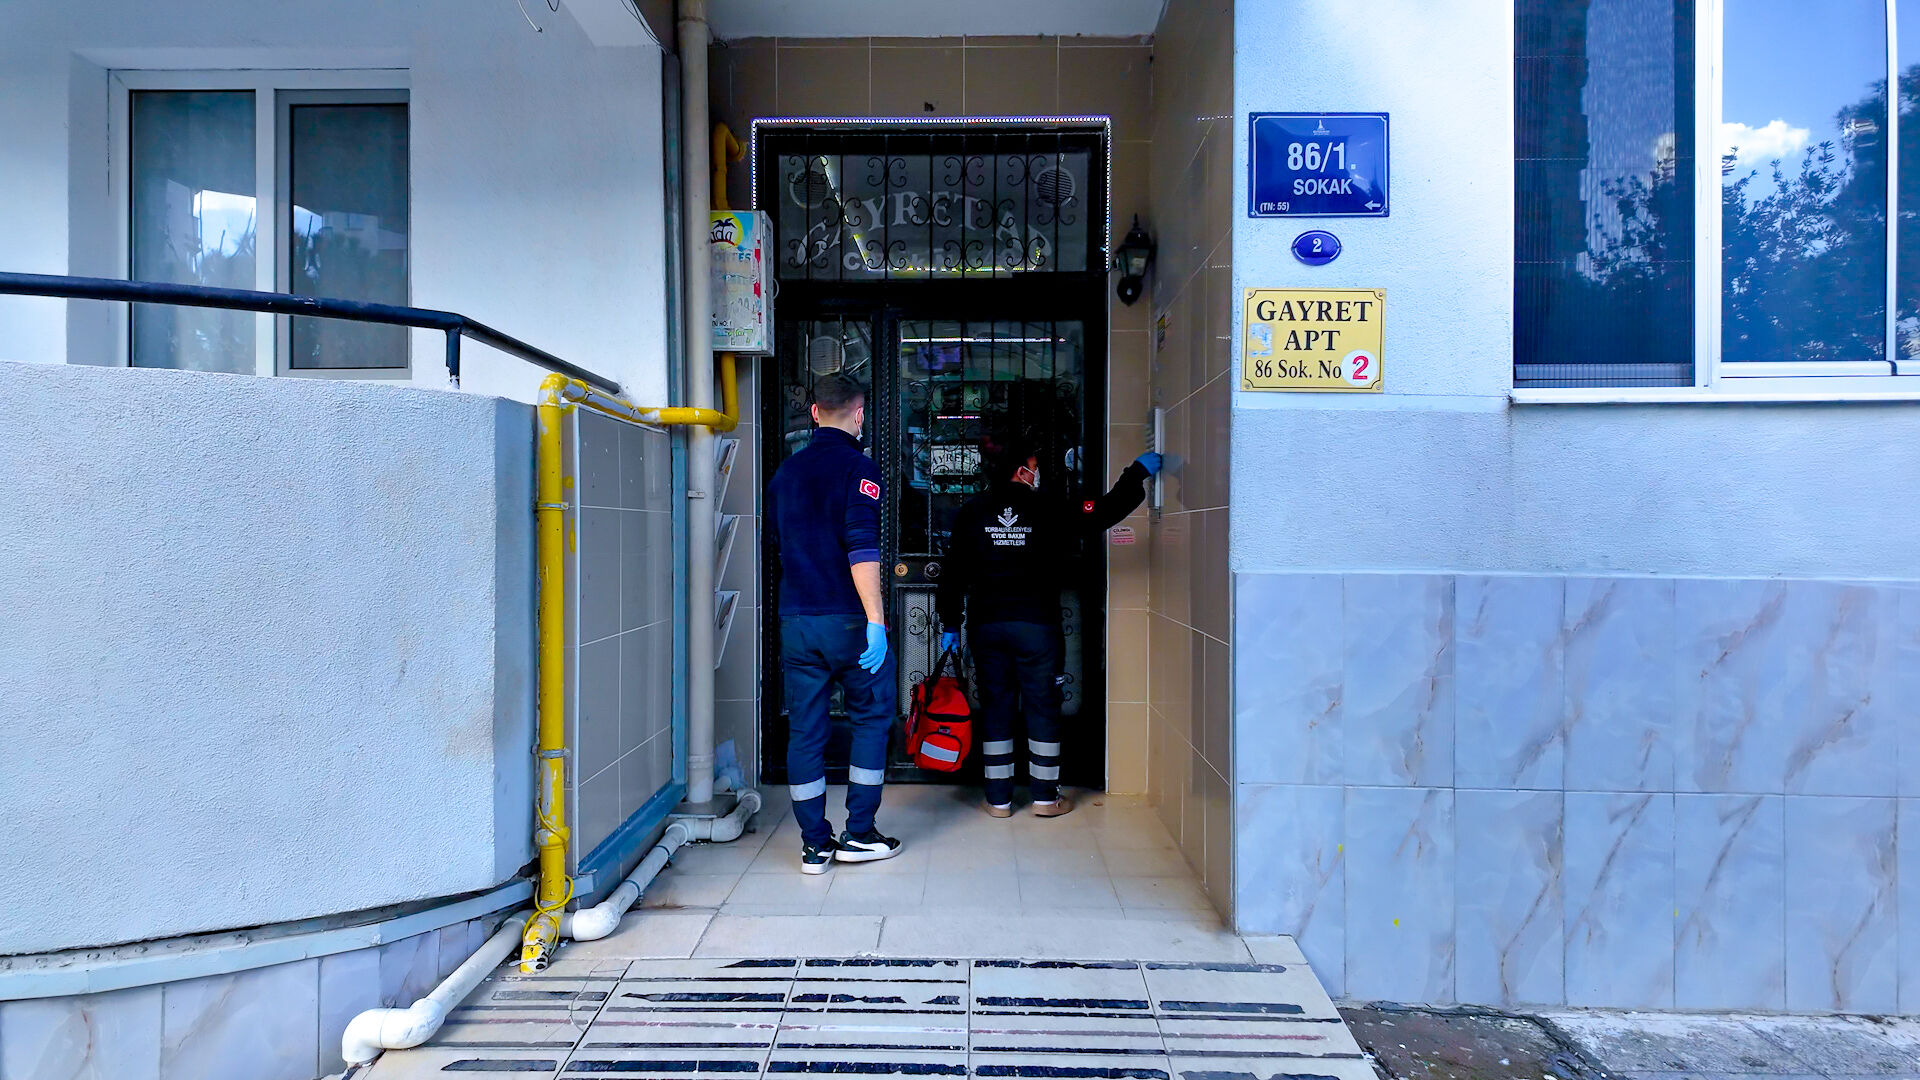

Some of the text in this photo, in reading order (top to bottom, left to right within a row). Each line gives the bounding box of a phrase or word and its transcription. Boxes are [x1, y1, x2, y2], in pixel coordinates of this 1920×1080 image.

[1287, 142, 1356, 172] 86/1.
[1293, 178, 1353, 195] SOKAK
[1259, 201, 1290, 212] (TN: 55)
[1312, 238, 1323, 253] 2
[1256, 300, 1373, 322] GAYRET
[1284, 330, 1341, 351] APT
[1255, 359, 1272, 378] 86
[1278, 359, 1312, 379] Sok.
[1352, 355, 1370, 380] 2
